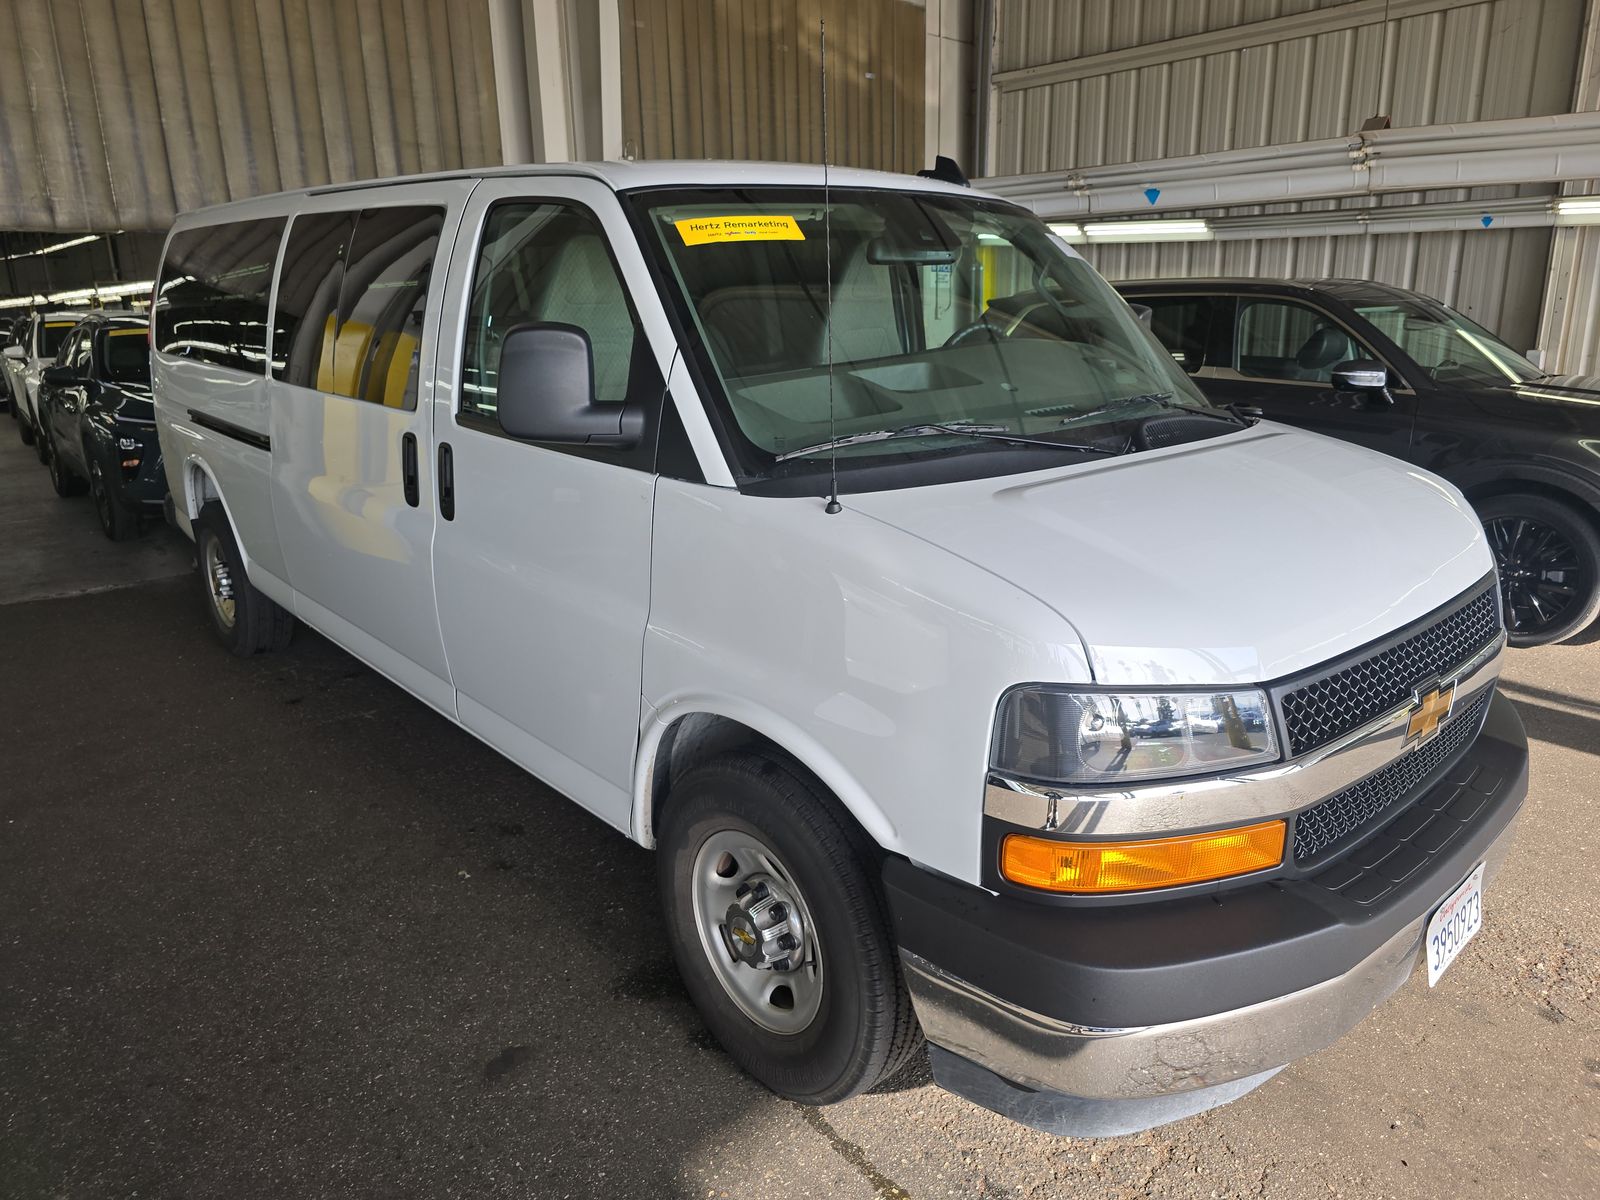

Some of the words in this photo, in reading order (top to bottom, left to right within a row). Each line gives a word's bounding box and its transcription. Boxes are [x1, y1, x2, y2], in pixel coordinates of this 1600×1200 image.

[690, 223, 720, 231] Hertz
[724, 221, 789, 229] Remarketing
[1433, 891, 1479, 971] 39509Z3
